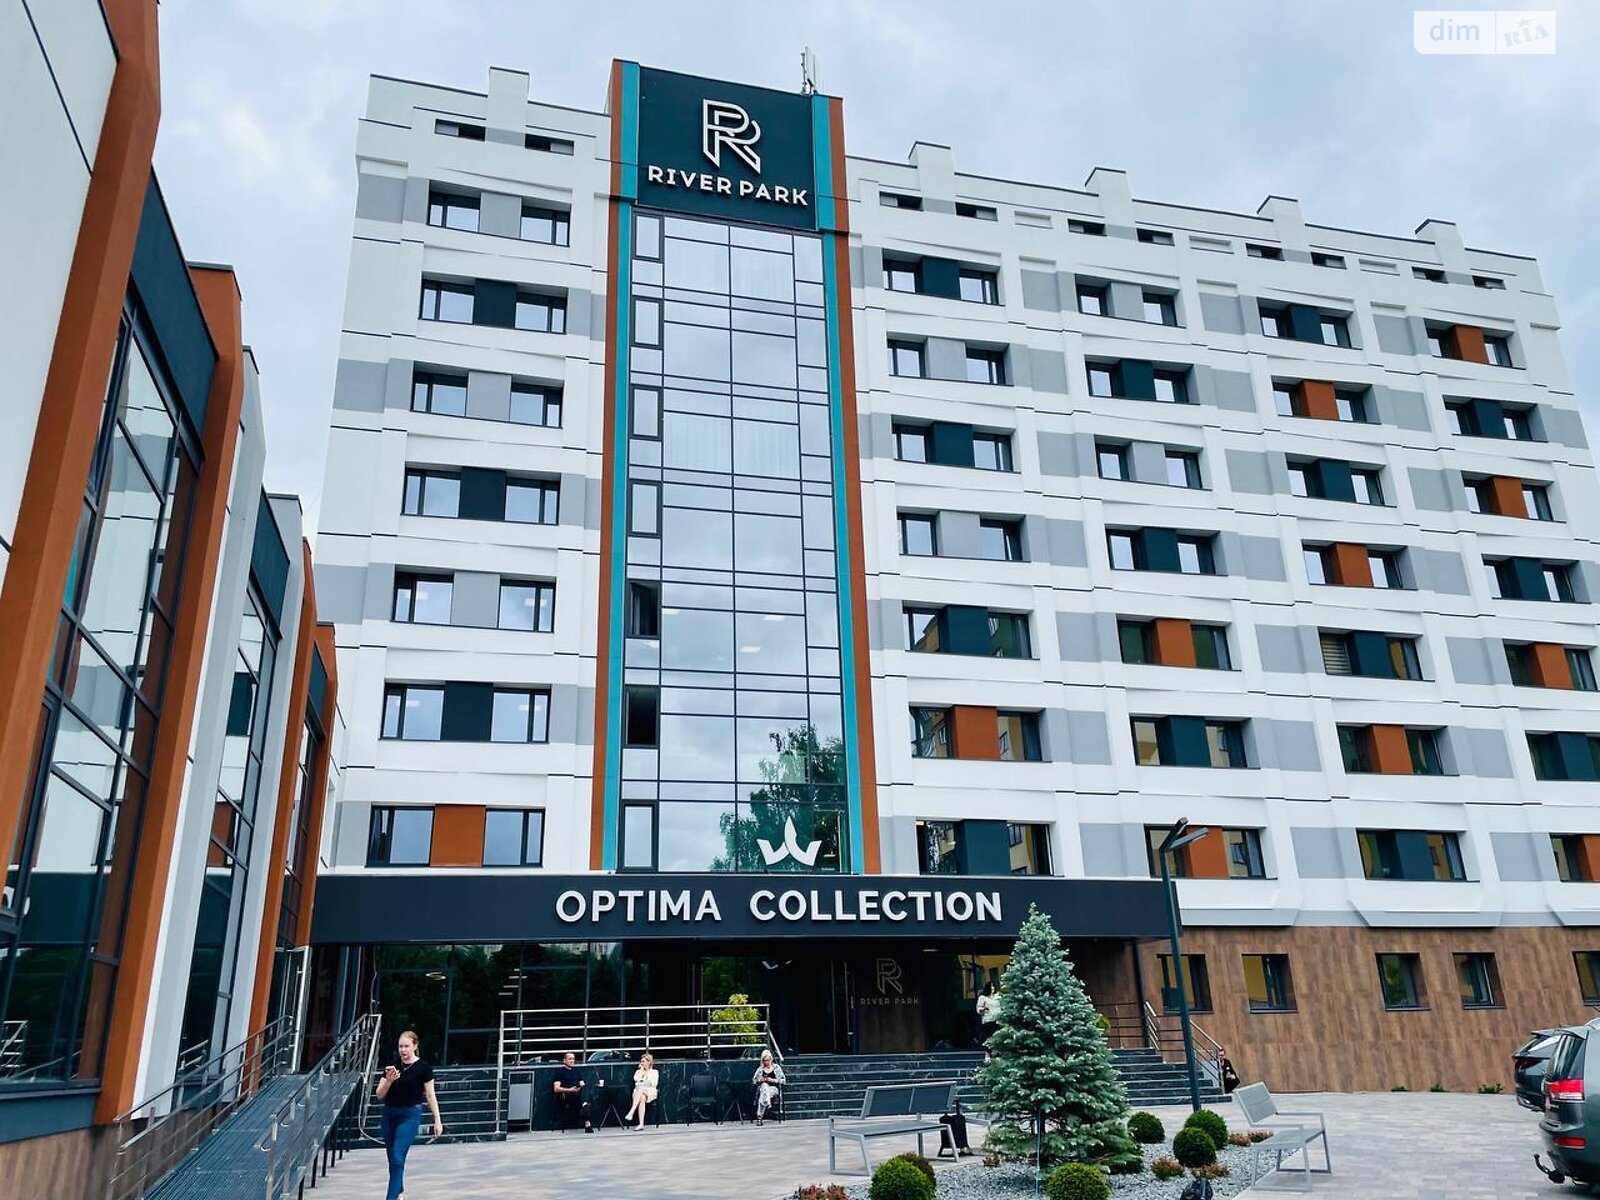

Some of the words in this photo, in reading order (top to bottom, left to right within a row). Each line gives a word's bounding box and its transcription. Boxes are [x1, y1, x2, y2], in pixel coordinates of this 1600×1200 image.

[648, 165, 732, 195] RIVER
[739, 180, 808, 206] PARK
[555, 889, 722, 923] OPTIMA
[750, 890, 1003, 922] COLLECTION
[860, 997, 890, 1006] RIVER
[894, 997, 919, 1006] PARK
